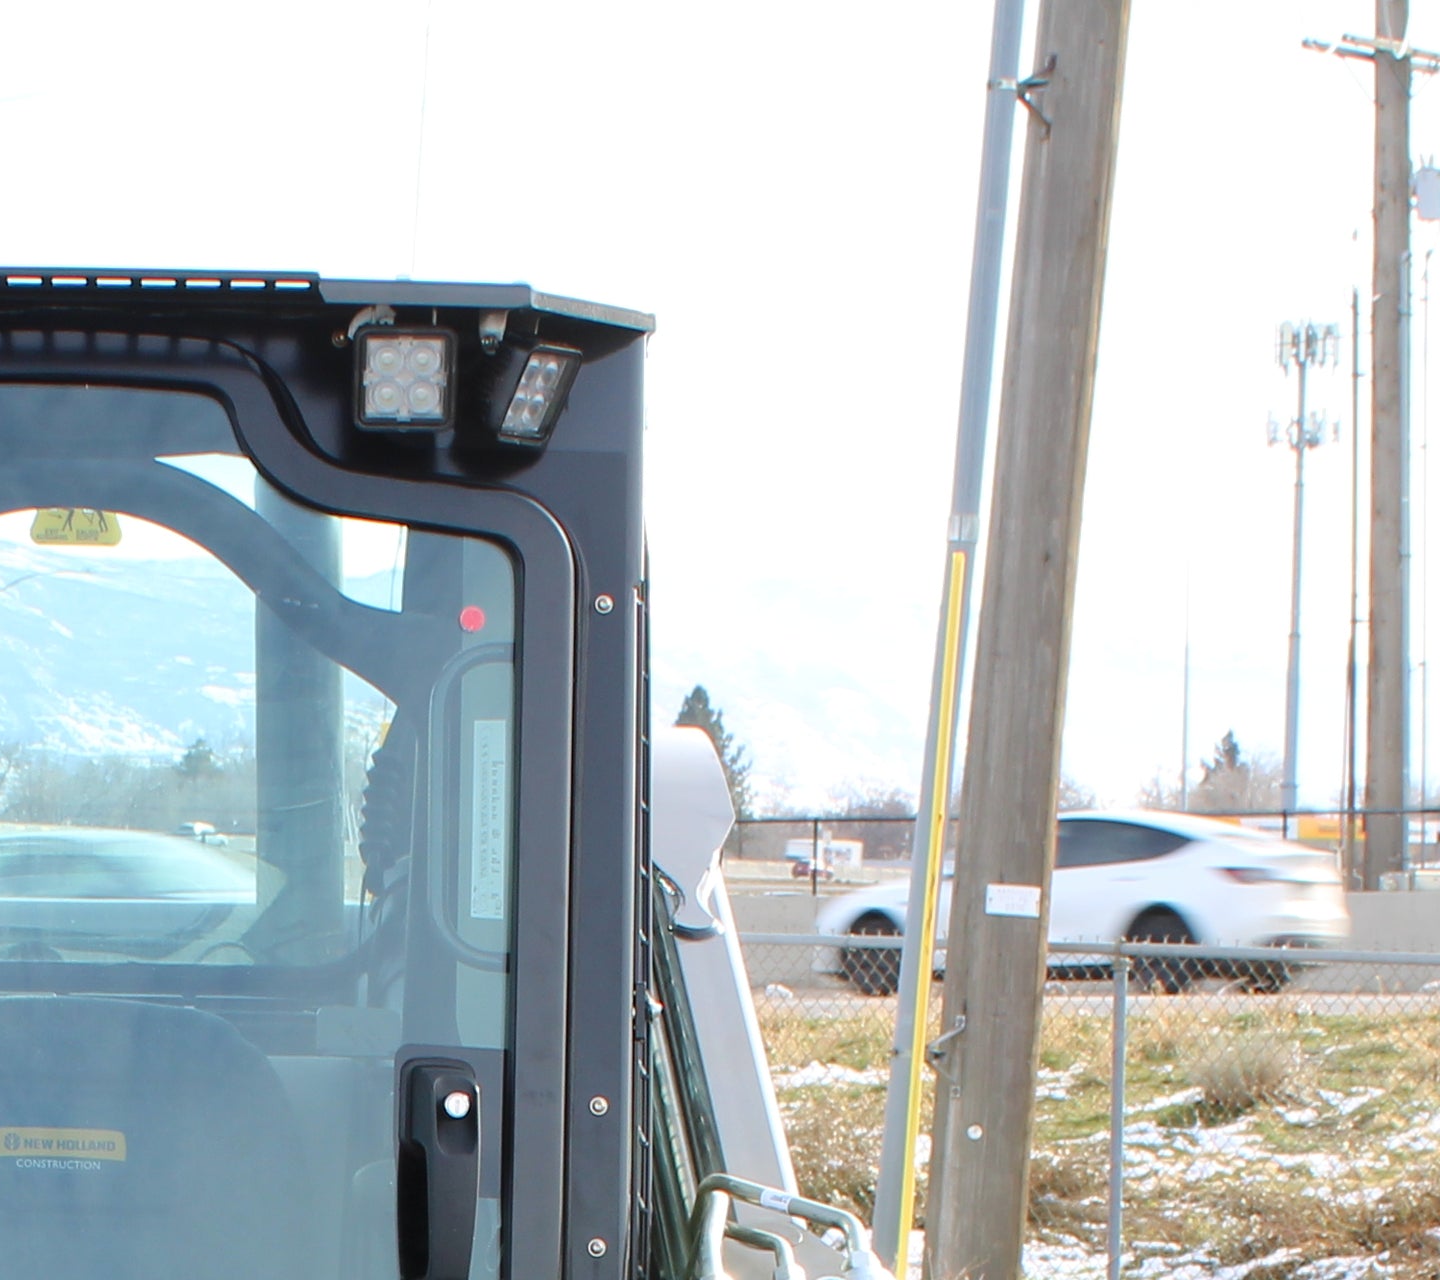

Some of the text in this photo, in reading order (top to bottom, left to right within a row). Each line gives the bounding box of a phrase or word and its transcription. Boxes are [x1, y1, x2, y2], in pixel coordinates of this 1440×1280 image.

[23, 1138, 116, 1152] NEW HOLLAND
[15, 1158, 102, 1170] CONSTRUCTION
